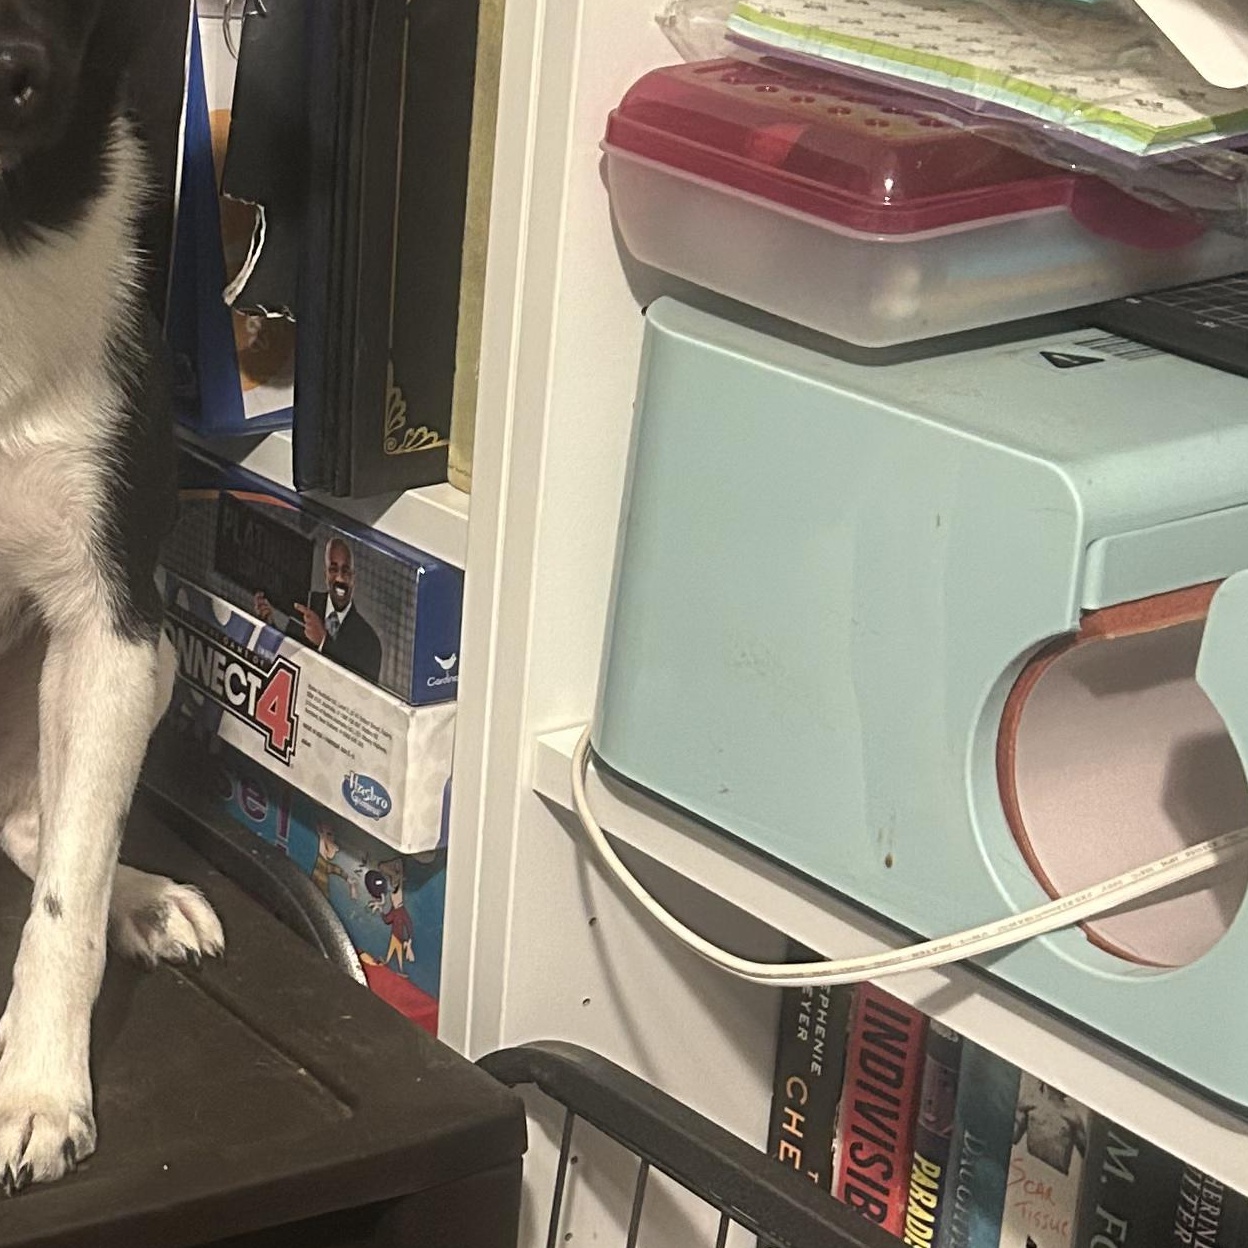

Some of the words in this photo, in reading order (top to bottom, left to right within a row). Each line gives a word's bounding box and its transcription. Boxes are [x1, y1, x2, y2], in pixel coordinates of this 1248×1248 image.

[255, 667, 293, 751] 4
[344, 770, 388, 809] Hasbro
[779, 1076, 808, 1170] CHE
